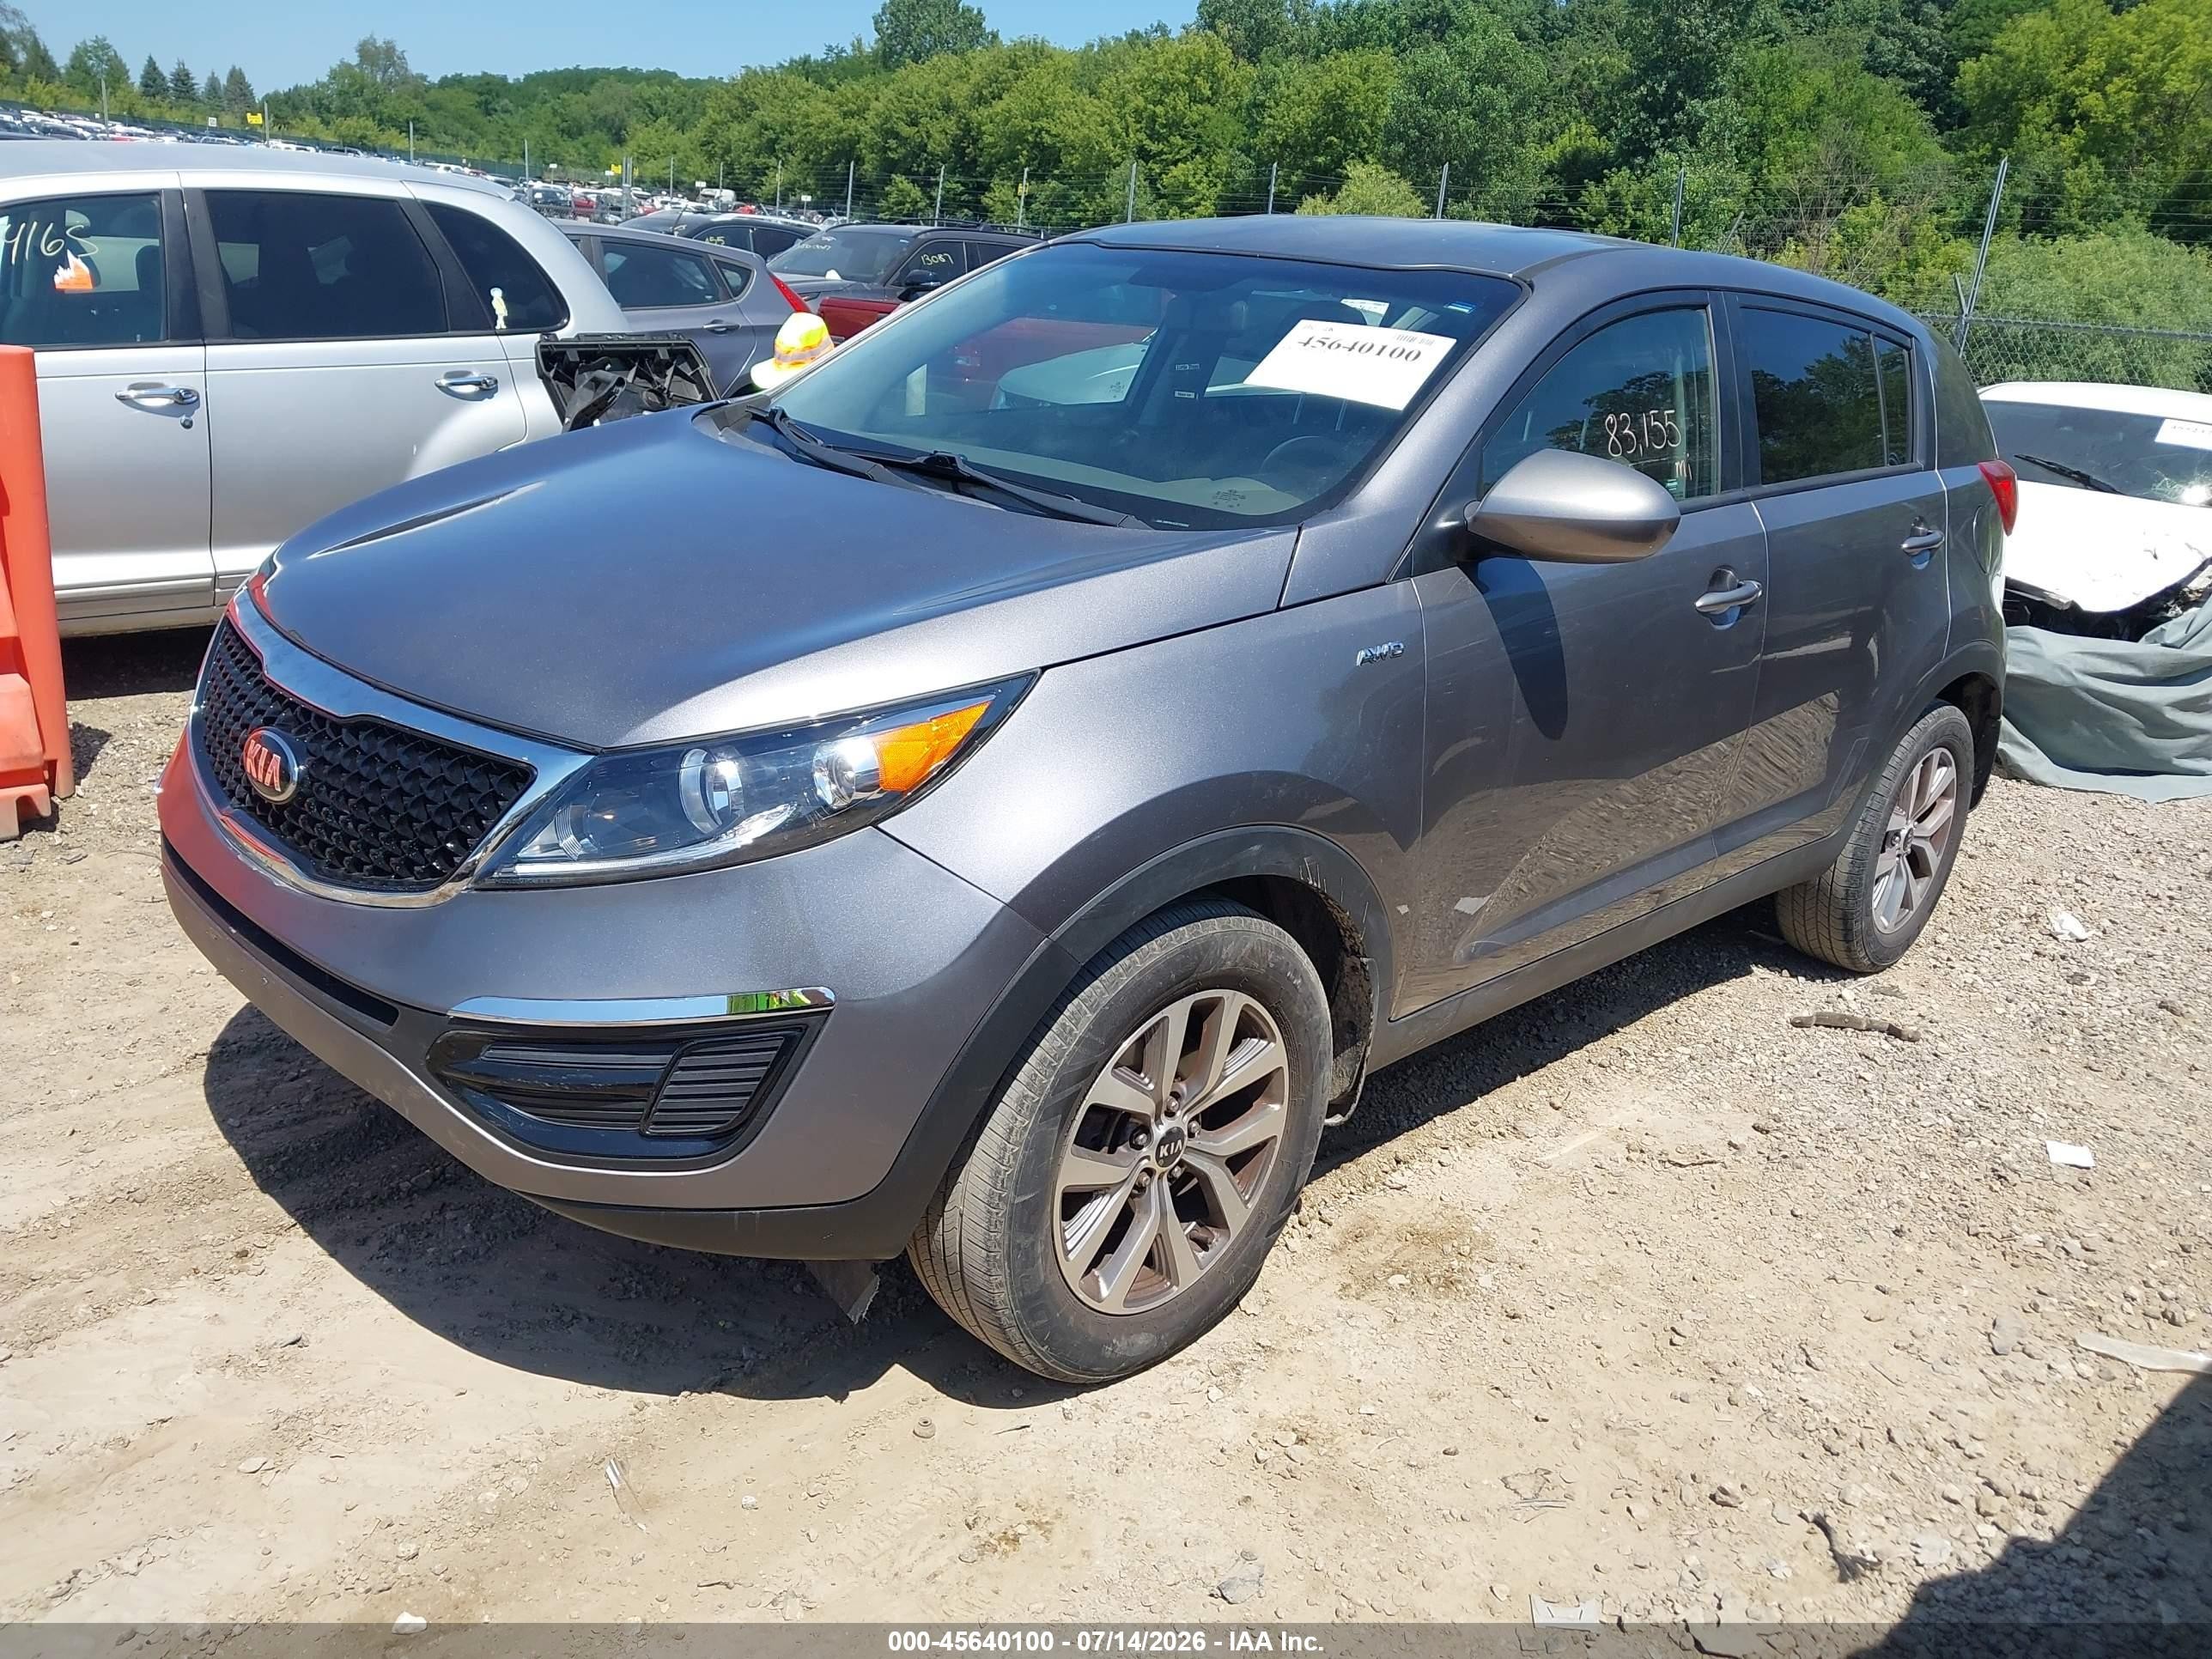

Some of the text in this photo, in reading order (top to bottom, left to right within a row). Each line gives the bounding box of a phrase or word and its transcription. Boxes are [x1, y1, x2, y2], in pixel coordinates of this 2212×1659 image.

[1297, 334, 1422, 362] 45640100
[1605, 410, 1681, 457] 83,155
[1674, 453, 1692, 481] mi
[1356, 641, 1405, 666] AWD
[246, 738, 282, 793] KIA
[1159, 1139, 1182, 1158] KIA
